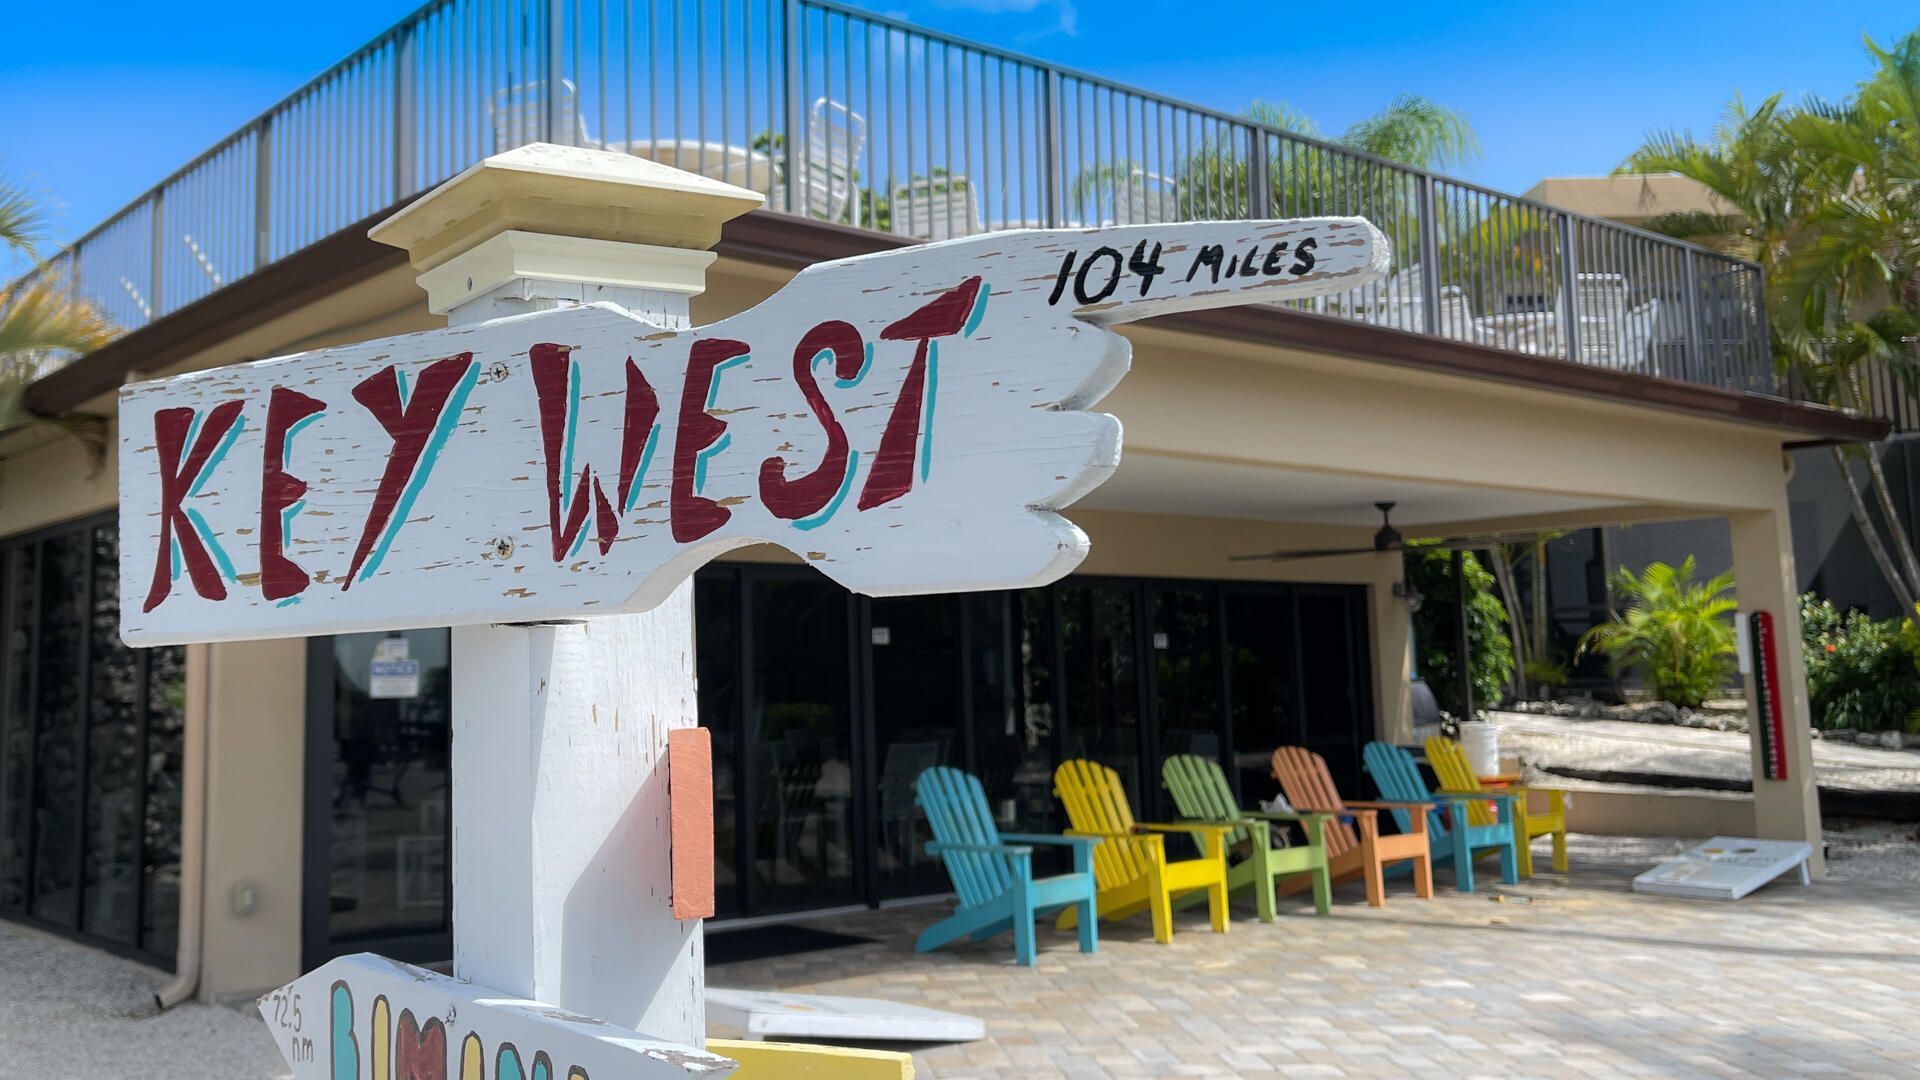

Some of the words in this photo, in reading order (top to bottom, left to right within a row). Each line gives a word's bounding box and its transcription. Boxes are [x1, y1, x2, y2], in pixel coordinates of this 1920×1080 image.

[1048, 238, 1165, 306] 104
[1185, 236, 1318, 285] MILES
[142, 351, 480, 614] KEY
[529, 275, 991, 563] WEST
[272, 994, 303, 1033] 72.5
